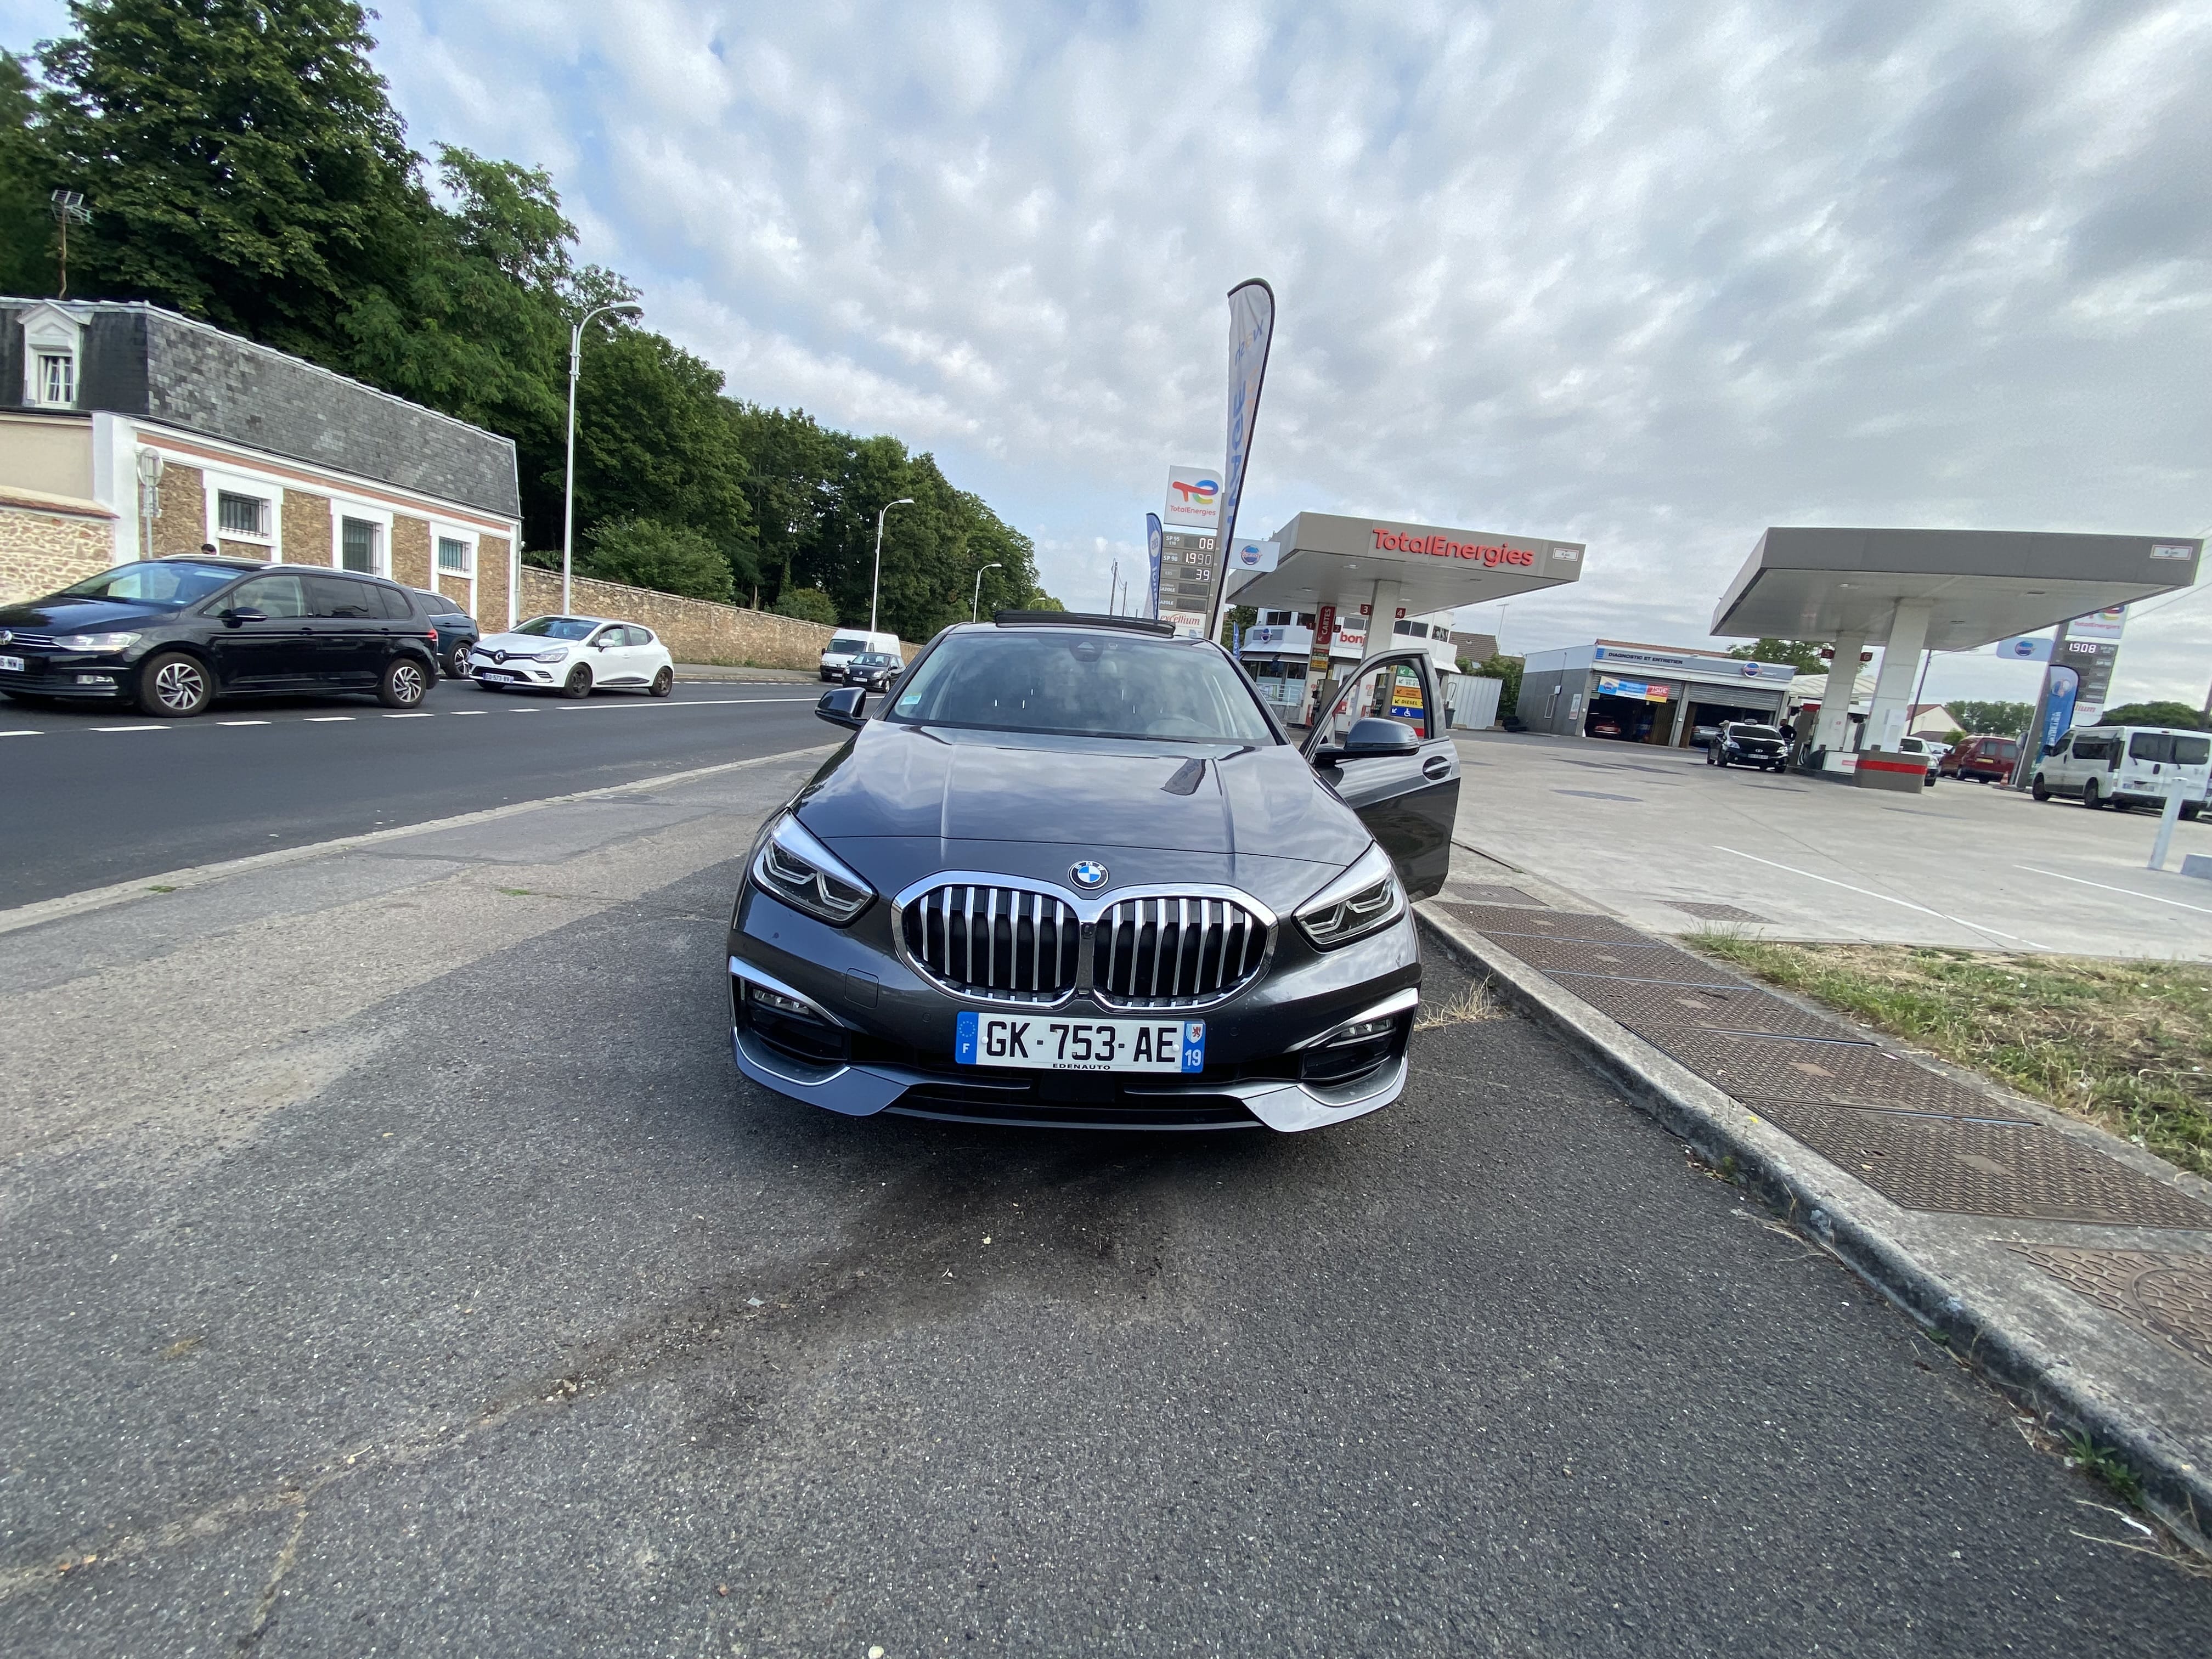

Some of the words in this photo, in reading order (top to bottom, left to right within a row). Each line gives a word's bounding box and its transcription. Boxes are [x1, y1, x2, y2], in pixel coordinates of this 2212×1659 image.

[1170, 505, 1216, 516] TotalEnergies
[1199, 538, 1214, 550] 08
[1373, 528, 1534, 567] TotalEnergies
[1195, 569, 1210, 580] 39
[1363, 606, 1368, 614] 3
[1160, 613, 1200, 625] excellium
[1321, 608, 1331, 635] CARTES
[1340, 631, 1367, 647] bonj
[1608, 652, 1643, 660] DIAGNOSTIC
[962, 1043, 970, 1054] F
[1184, 1049, 1202, 1066] 19
